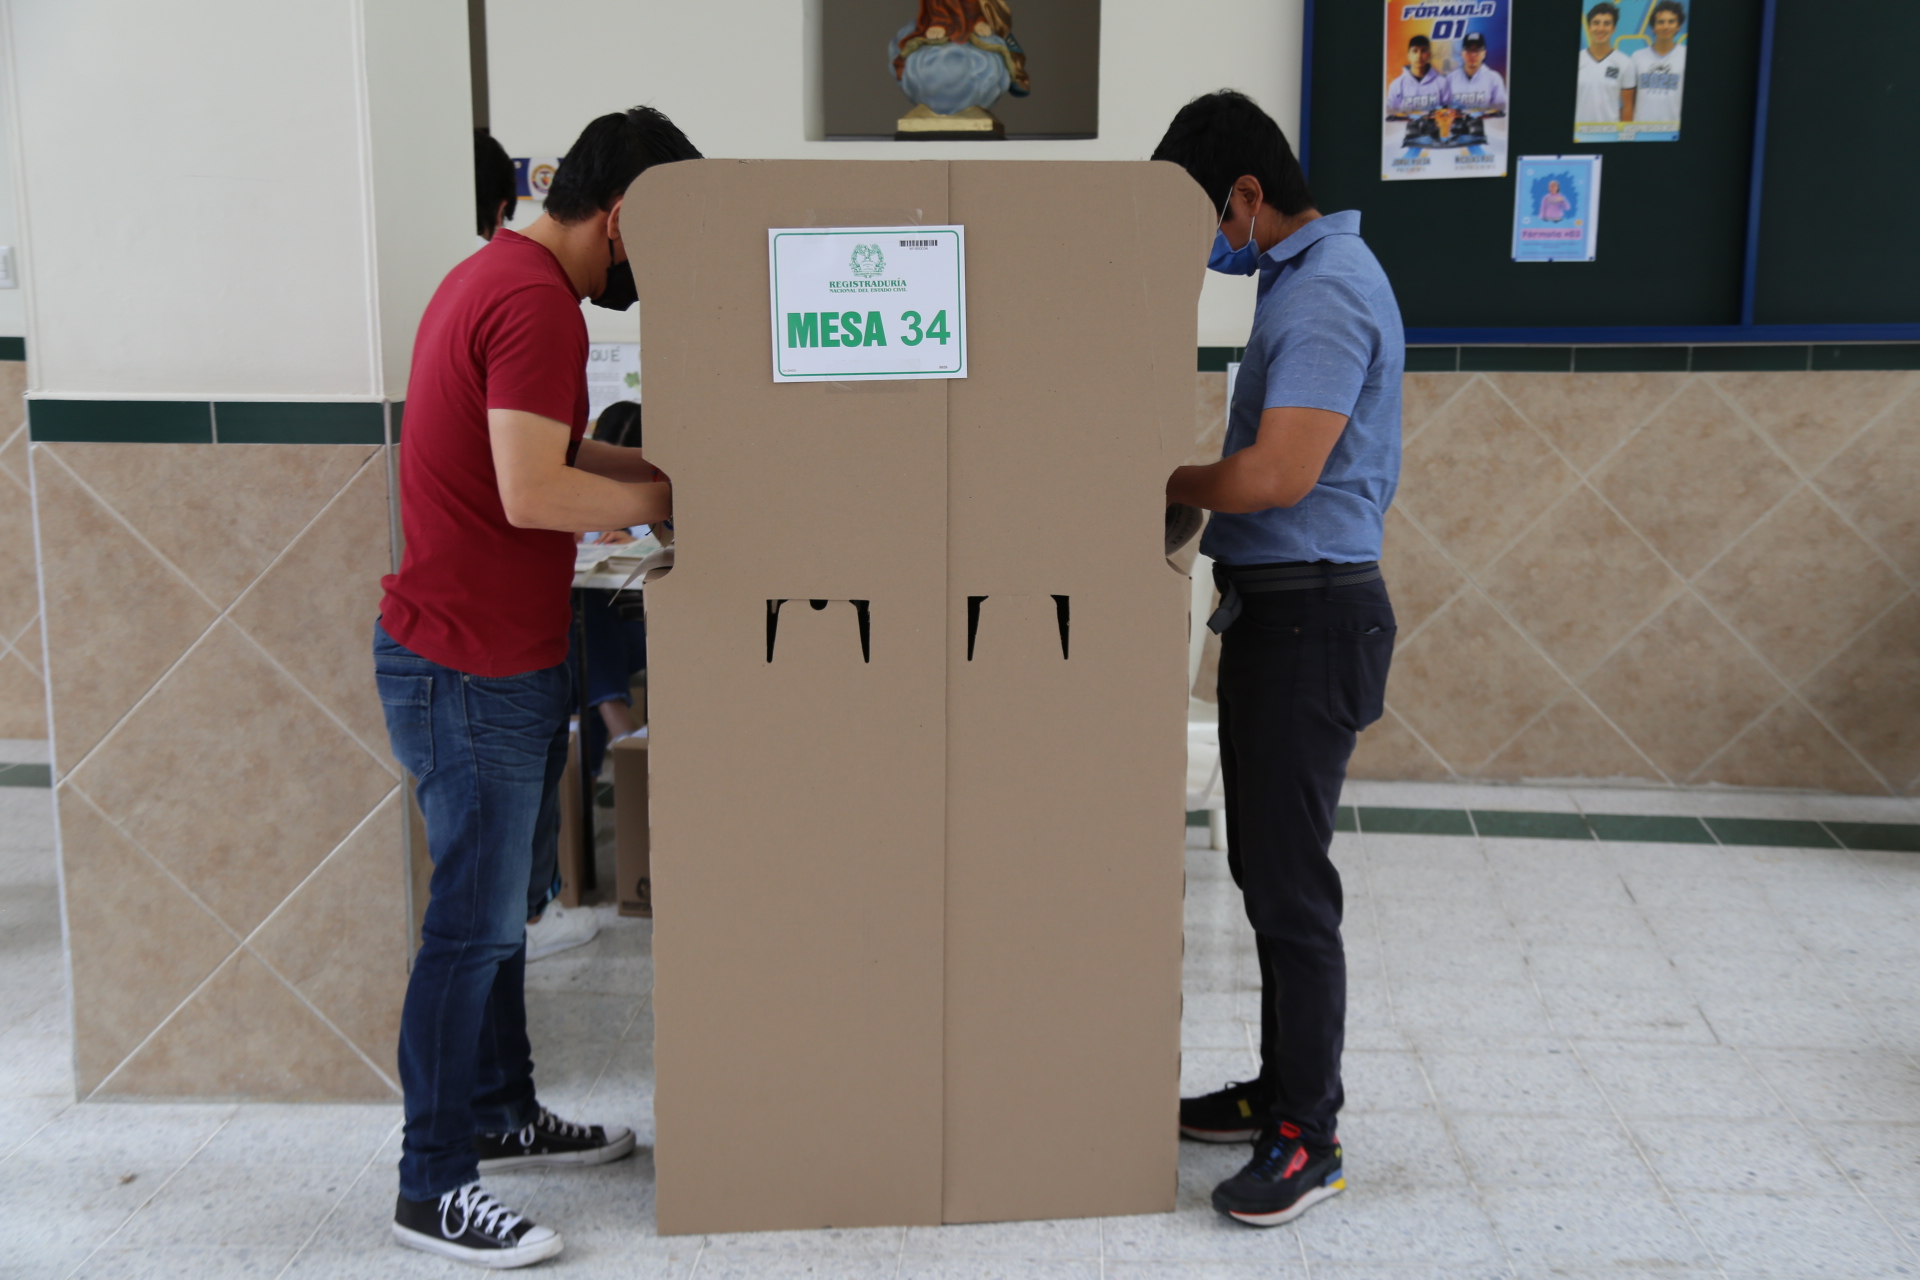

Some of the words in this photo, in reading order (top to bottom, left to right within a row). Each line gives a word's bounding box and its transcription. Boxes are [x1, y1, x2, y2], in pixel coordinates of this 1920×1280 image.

[1402, 2, 1495, 19] FÓRMULA
[1430, 20, 1467, 40] 01
[829, 278, 907, 288] REGISTRADURÍA
[787, 311, 887, 348] MESA
[900, 309, 951, 347] 34
